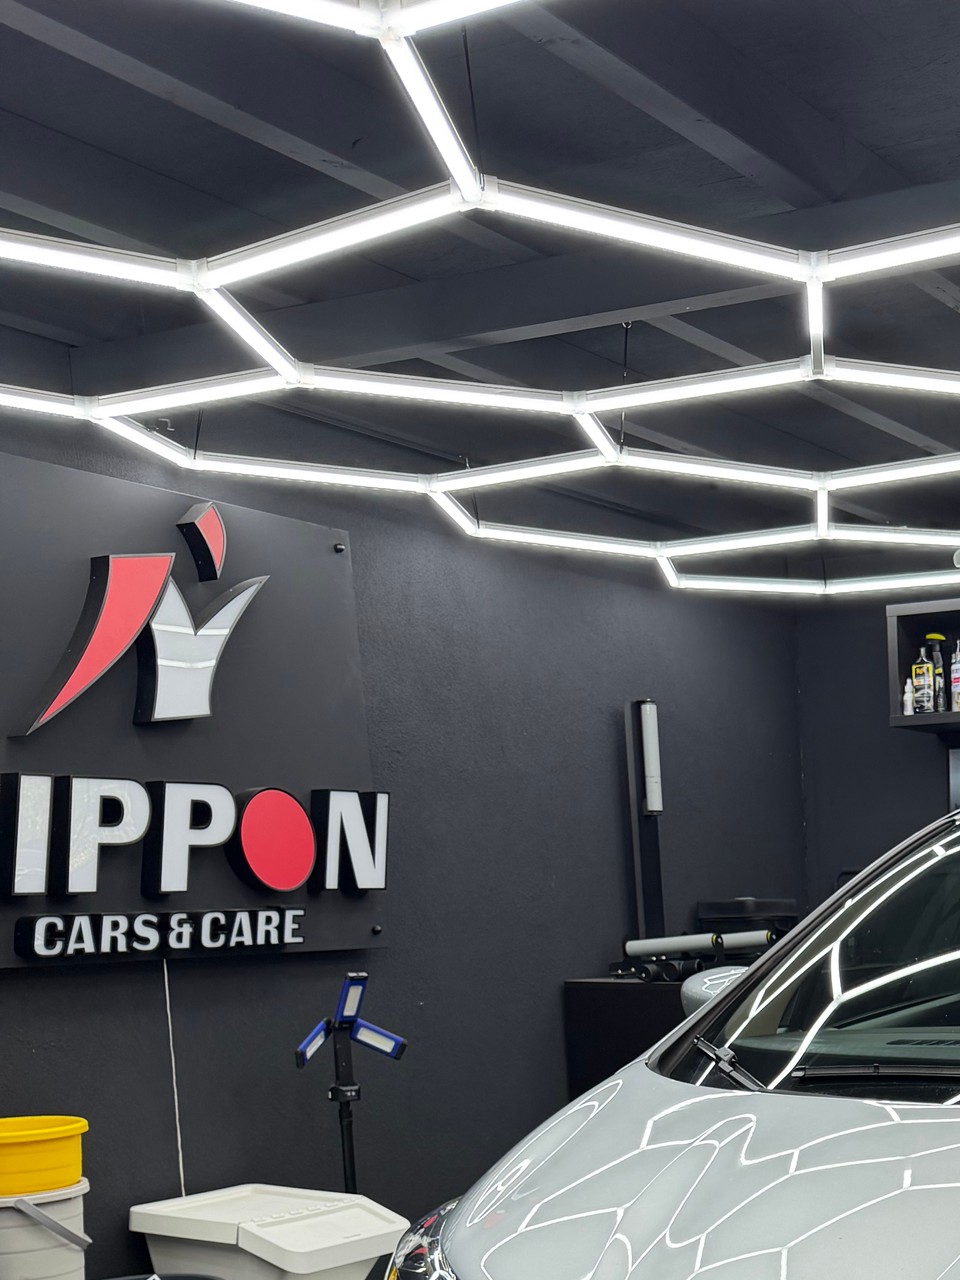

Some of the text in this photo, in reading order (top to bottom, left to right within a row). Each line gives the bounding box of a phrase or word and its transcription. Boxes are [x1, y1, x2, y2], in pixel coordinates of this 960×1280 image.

[34, 909, 306, 957] CARS & CARE
